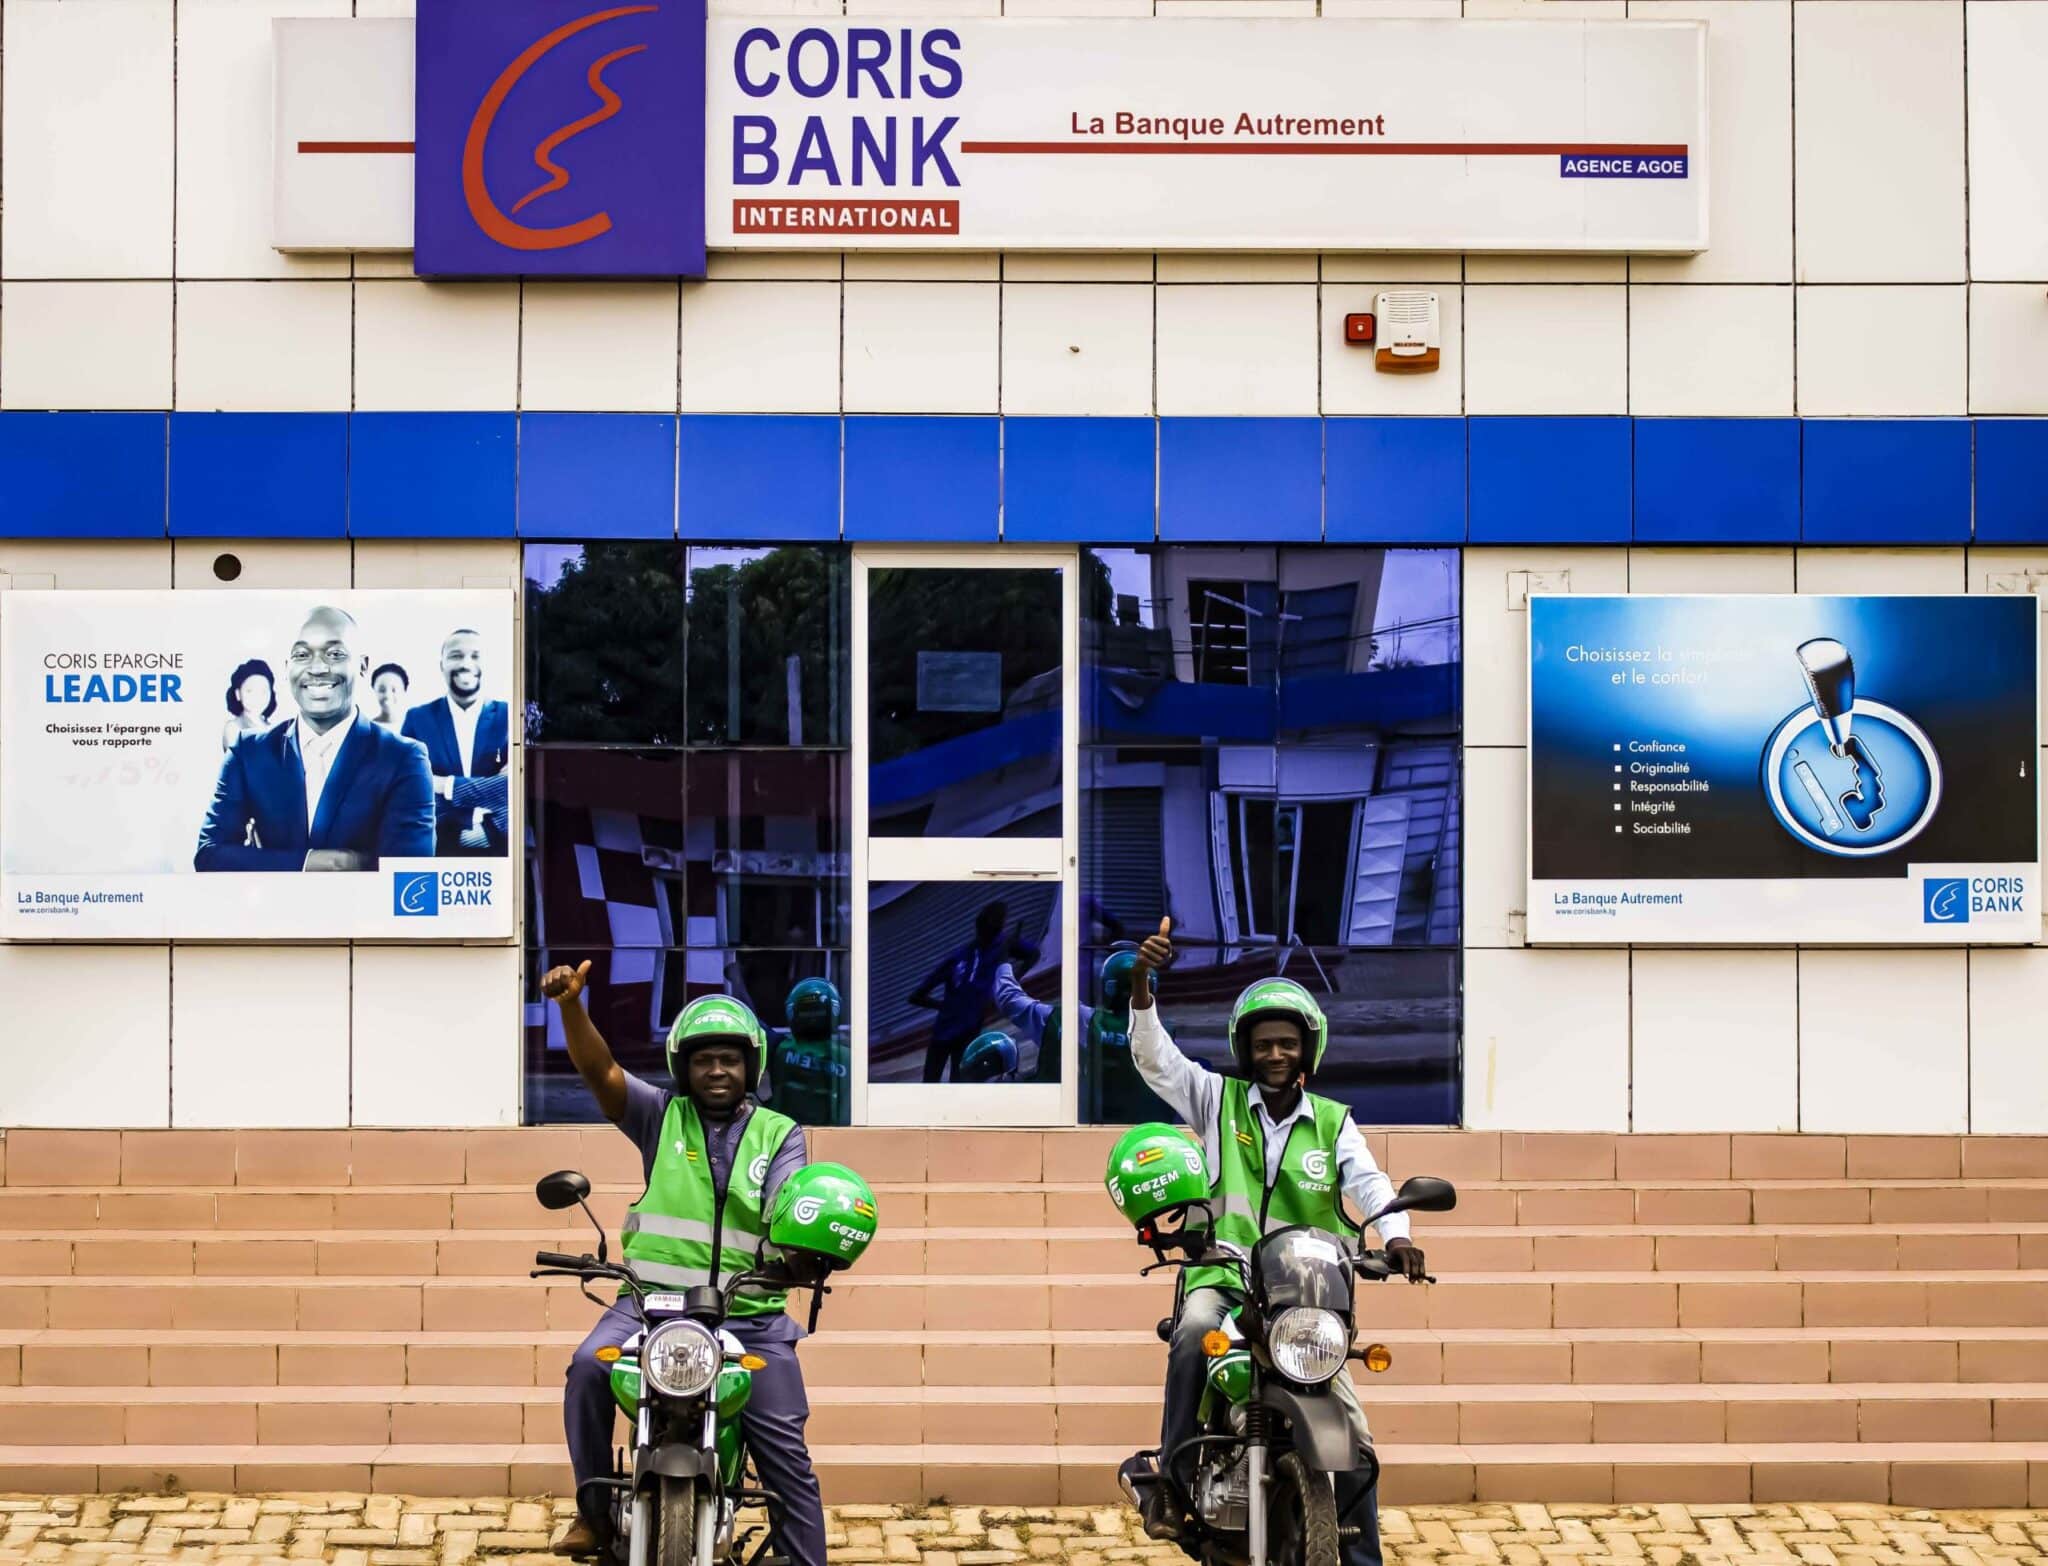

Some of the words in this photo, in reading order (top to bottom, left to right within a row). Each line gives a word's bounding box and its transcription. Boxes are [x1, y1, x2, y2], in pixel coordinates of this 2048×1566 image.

[734, 27, 963, 99] CORIS
[1071, 111, 1104, 134] La
[1115, 111, 1225, 141] Banque
[1233, 112, 1385, 136] Autrement
[733, 115, 961, 187] BANK
[1565, 159, 1633, 173] AGENCE
[1637, 160, 1684, 174] AGOE
[740, 207, 953, 227] INTERNATIONAL
[44, 653, 98, 669] CORIS
[104, 653, 184, 669] EPARGNE
[1566, 645, 1651, 662] Choisissez
[1657, 645, 1673, 662] la
[1611, 670, 1627, 685] et
[1632, 668, 1646, 685] le
[45, 674, 183, 703] LEADER
[46, 723, 103, 734] Choisissez
[164, 723, 182, 736] qui
[72, 738, 99, 746] vous
[102, 737, 152, 748] rapporte
[1629, 740, 1686, 752] Confiance
[1630, 761, 1690, 776] Originalité
[1630, 780, 1710, 795] Responsabilité
[1631, 800, 1676, 815] Intégrité
[1633, 821, 1691, 834] Sociabilité
[441, 871, 493, 887] CORIS
[1972, 878, 2024, 893] CORIS
[17, 891, 32, 903] La
[35, 891, 80, 906] Banque
[82, 891, 144, 903] Autrement
[441, 889, 492, 905] BANK
[1554, 892, 1569, 904] La
[1572, 892, 1618, 906] Banque
[1620, 892, 1683, 904] Autrement
[1972, 896, 2023, 912] BANK
[1132, 1170, 1179, 1195] GOZEM
